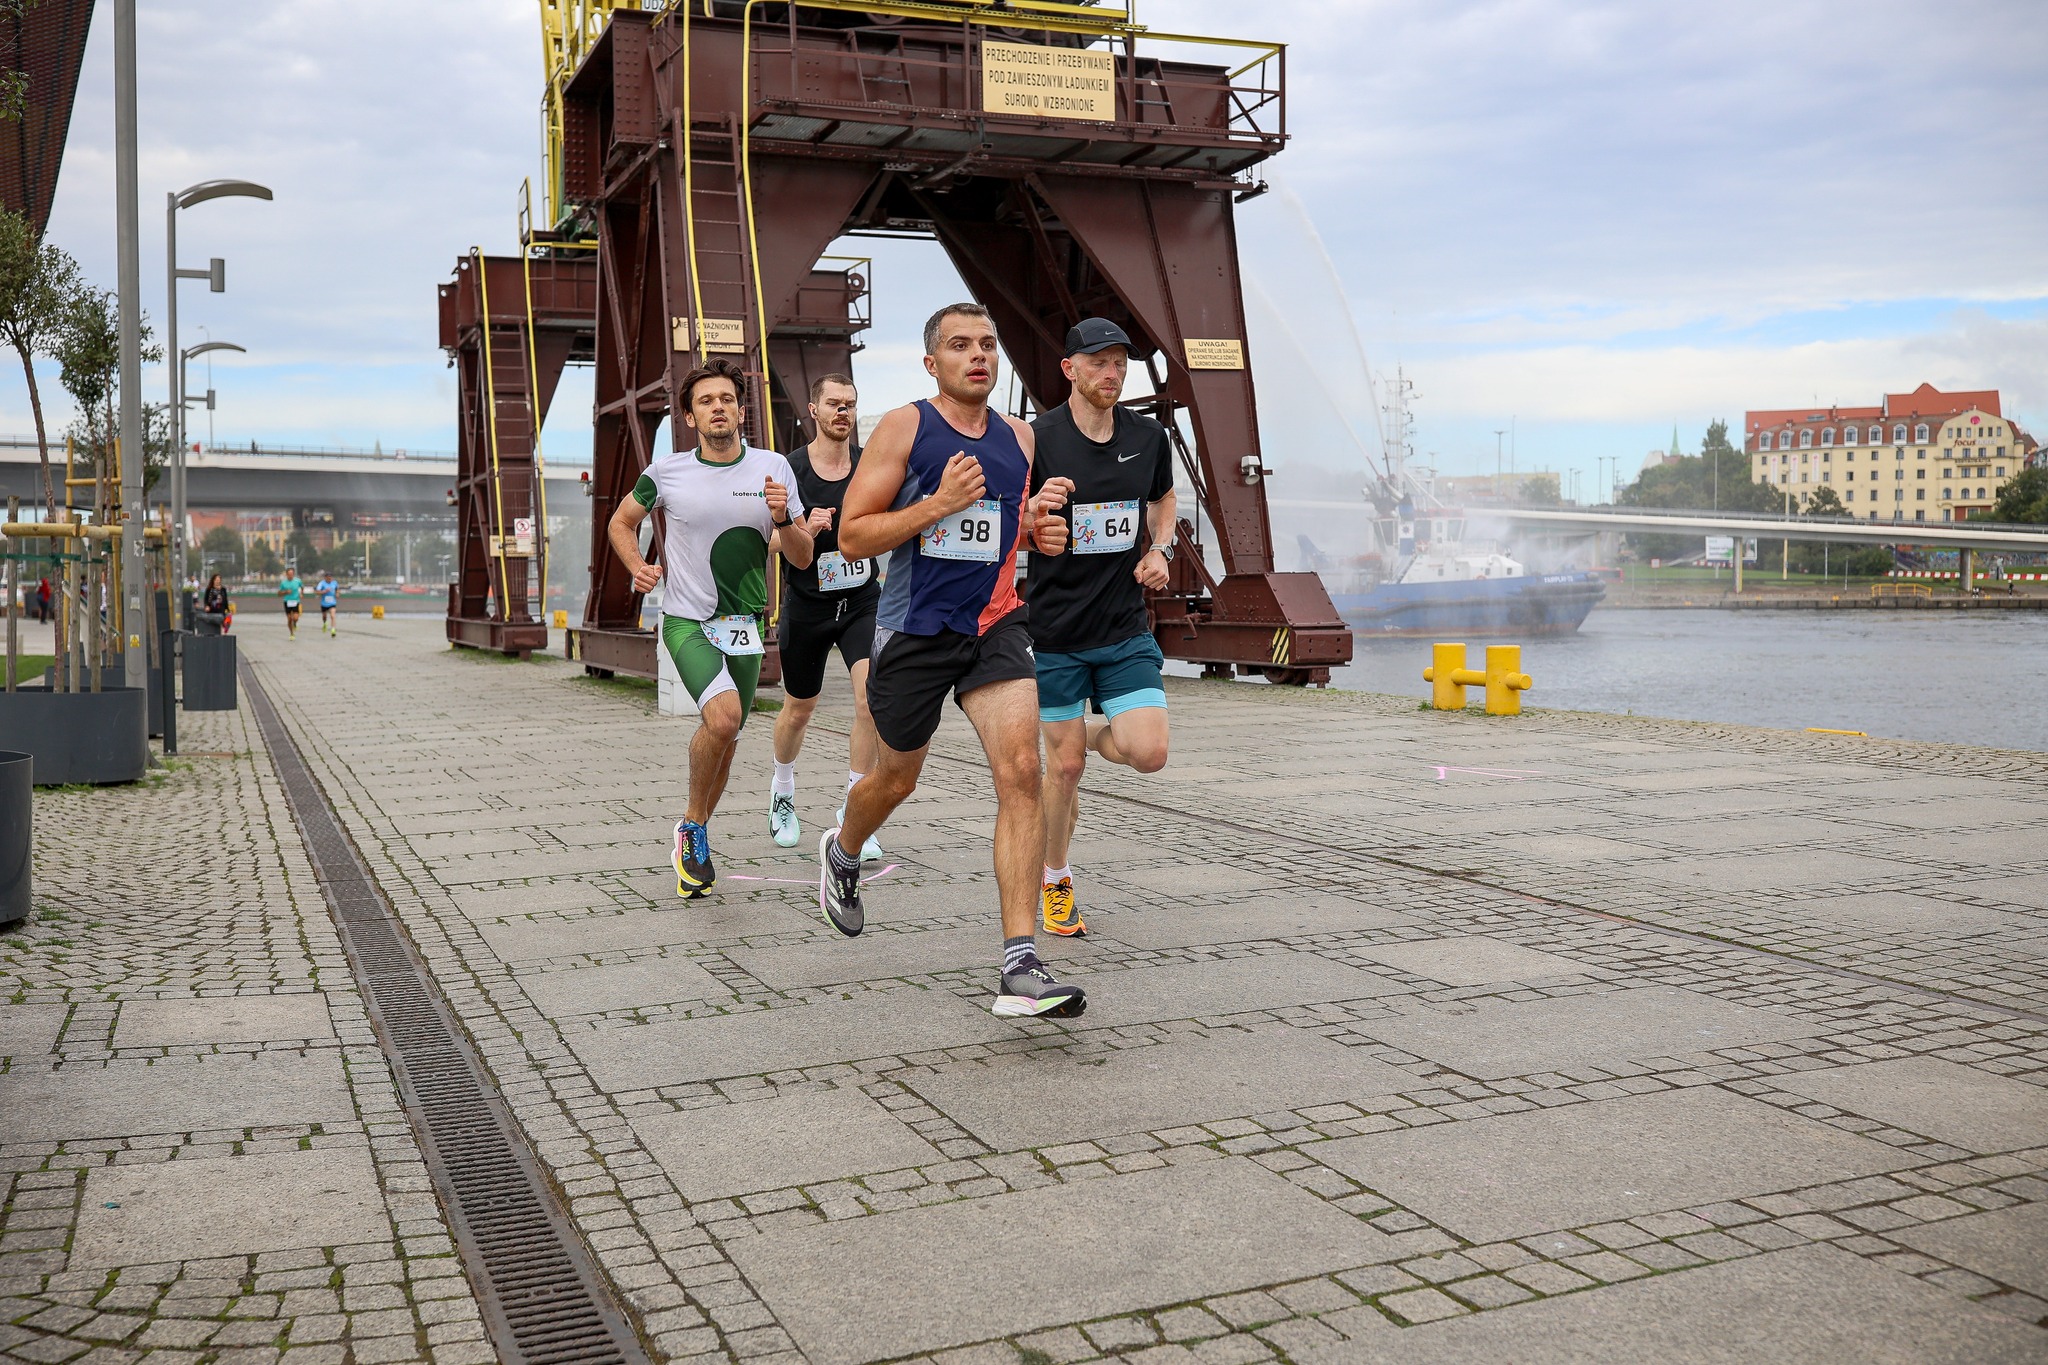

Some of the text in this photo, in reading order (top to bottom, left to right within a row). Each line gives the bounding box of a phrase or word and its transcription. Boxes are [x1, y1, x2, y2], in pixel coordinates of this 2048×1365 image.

[986, 47, 1051, 66] PRZECHODZENIE
[1057, 54, 1112, 71] PRZEBYWANIE
[989, 70, 1110, 91] POD ZAWIESZONYM ŁADUNKIEM
[1004, 93, 1095, 112] SUROWO WZBRONIONE
[1953, 438, 1976, 448] focus
[960, 518, 990, 542] 98
[1105, 517, 1131, 537] 64
[841, 560, 864, 577] 119
[730, 629, 750, 647] 73
[682, 831, 691, 861] HOKA
